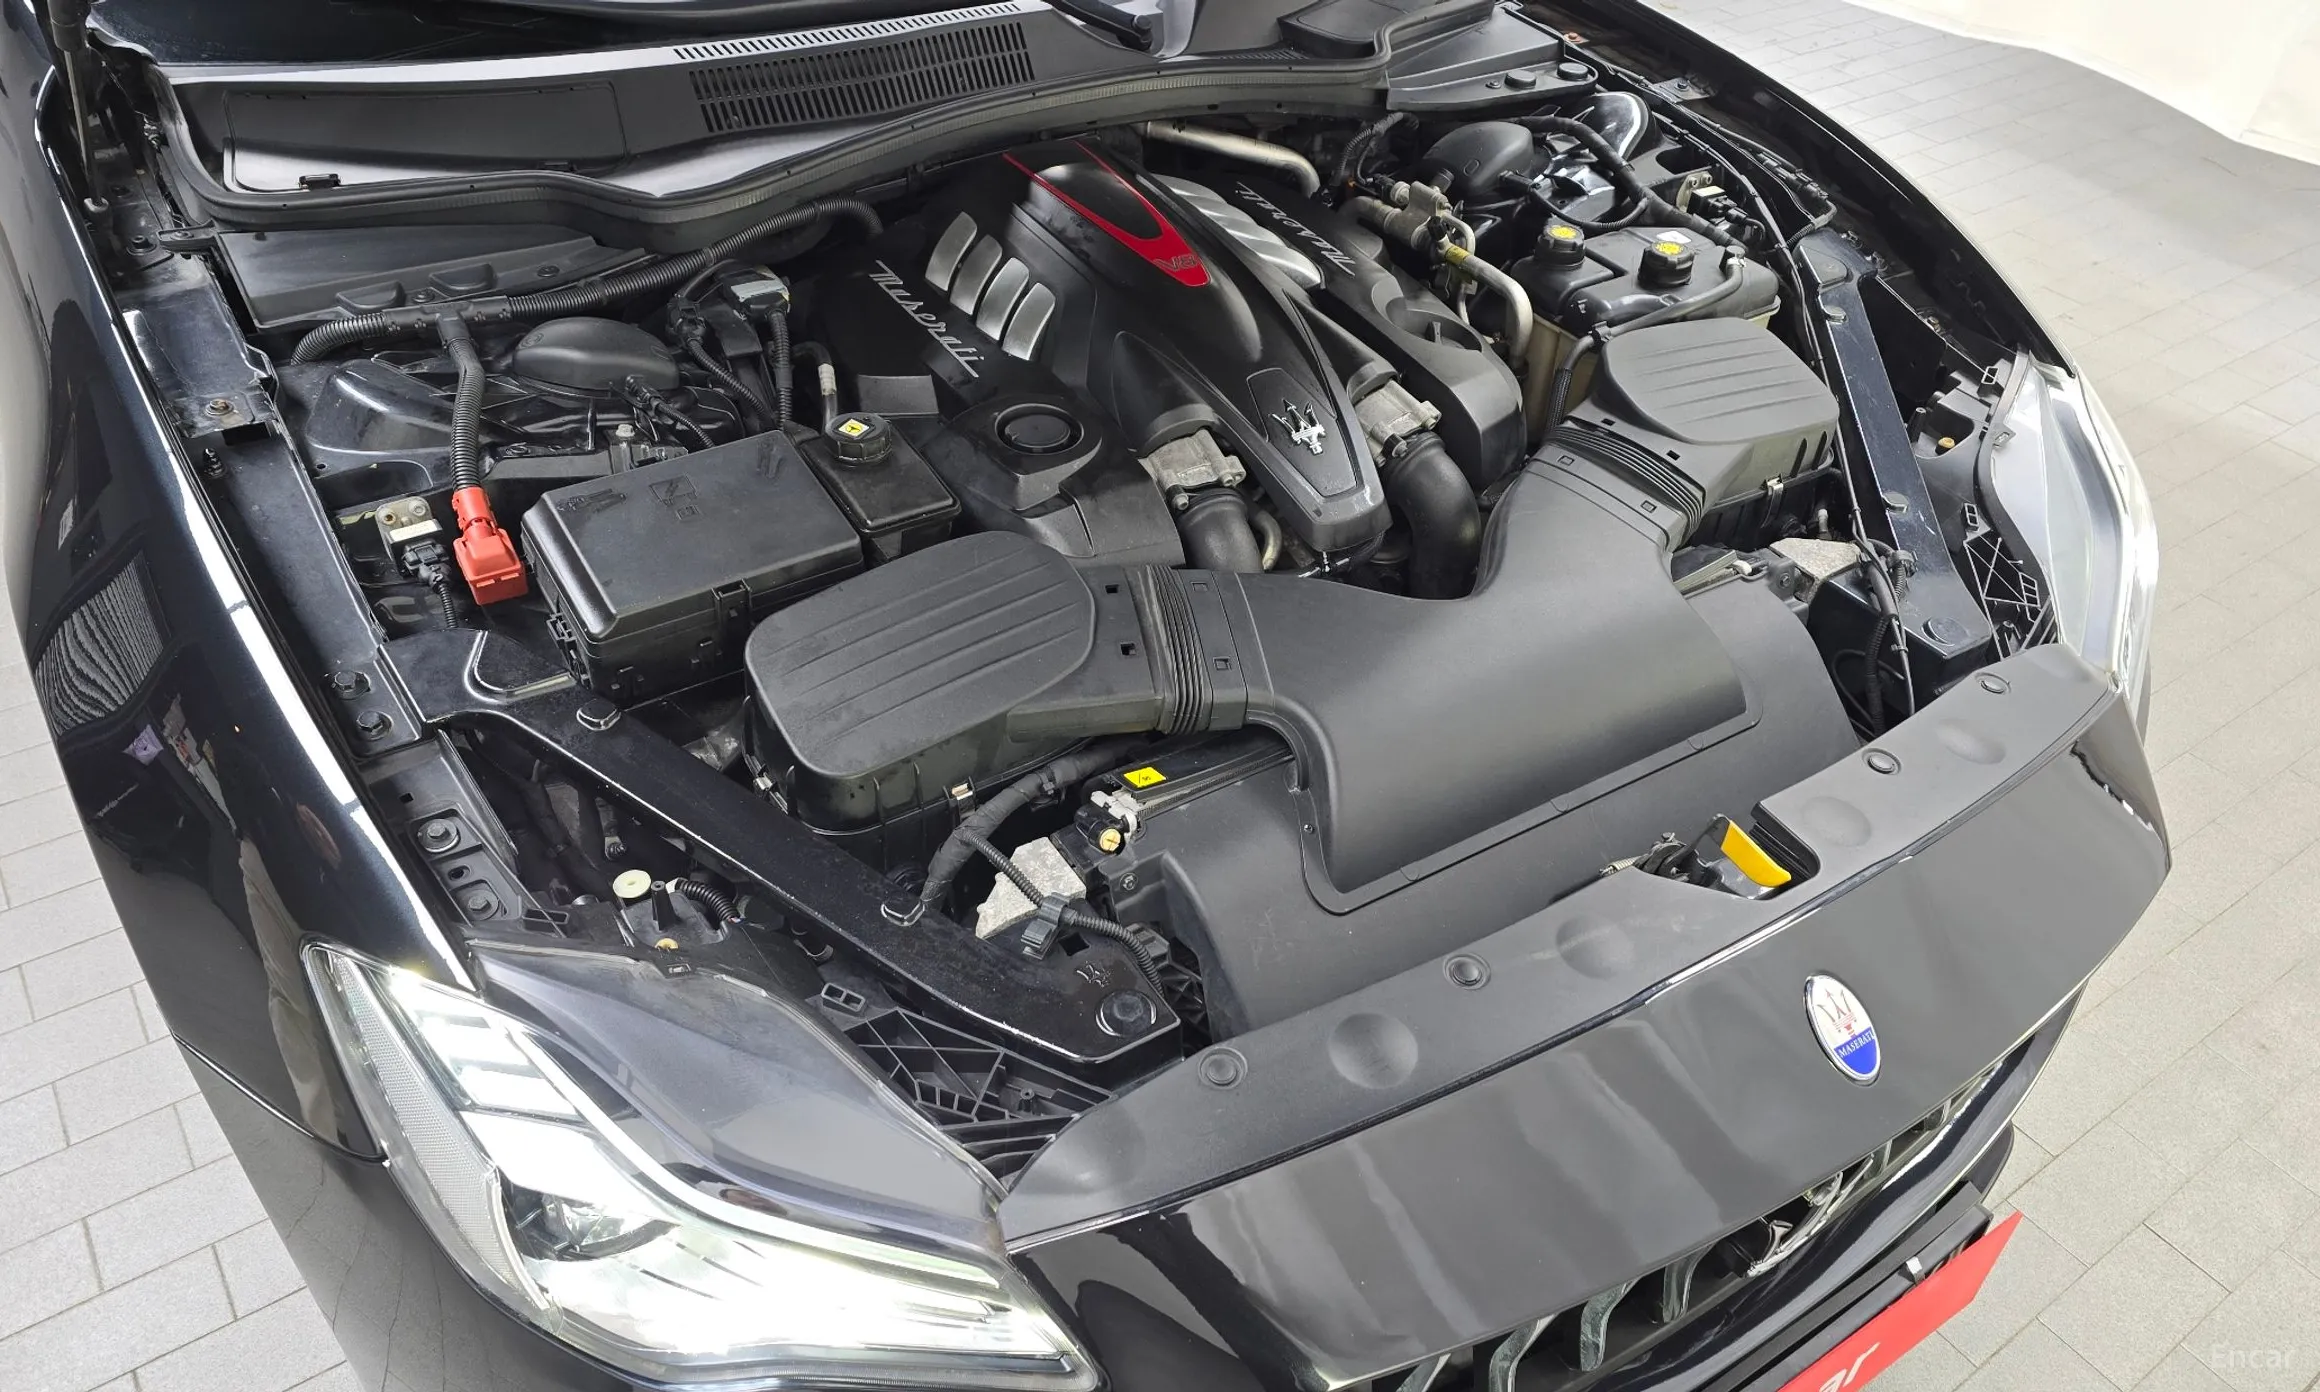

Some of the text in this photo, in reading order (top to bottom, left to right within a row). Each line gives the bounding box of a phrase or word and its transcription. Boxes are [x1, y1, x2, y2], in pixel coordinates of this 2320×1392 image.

[1235, 180, 1357, 277] Maserati
[1152, 253, 1198, 272] V8
[868, 259, 985, 378] Maserati
[1837, 1029, 1876, 1058] MASERATI
